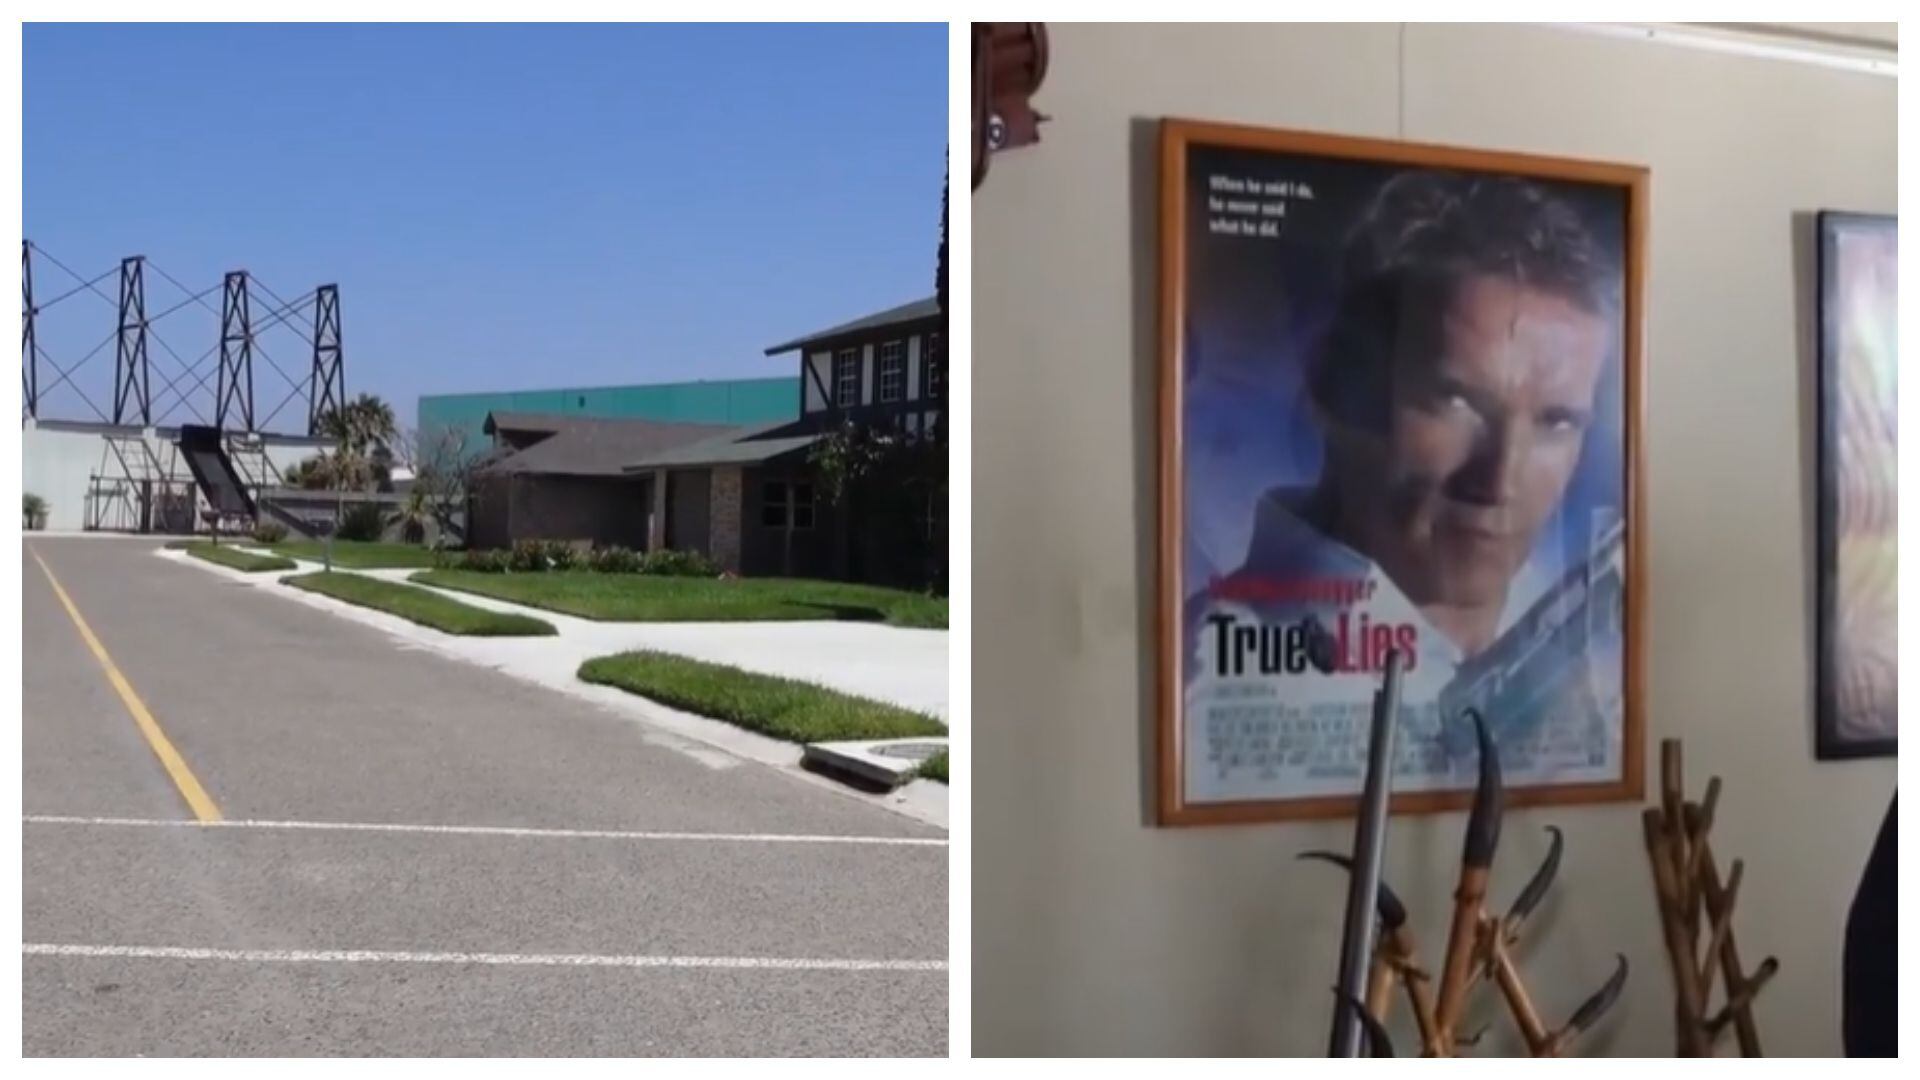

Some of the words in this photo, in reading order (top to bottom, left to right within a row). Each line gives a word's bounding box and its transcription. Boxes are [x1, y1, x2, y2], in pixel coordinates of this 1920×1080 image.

[1209, 176, 1245, 192] When
[1207, 614, 1305, 676] True
[1336, 613, 1417, 674] Lies
